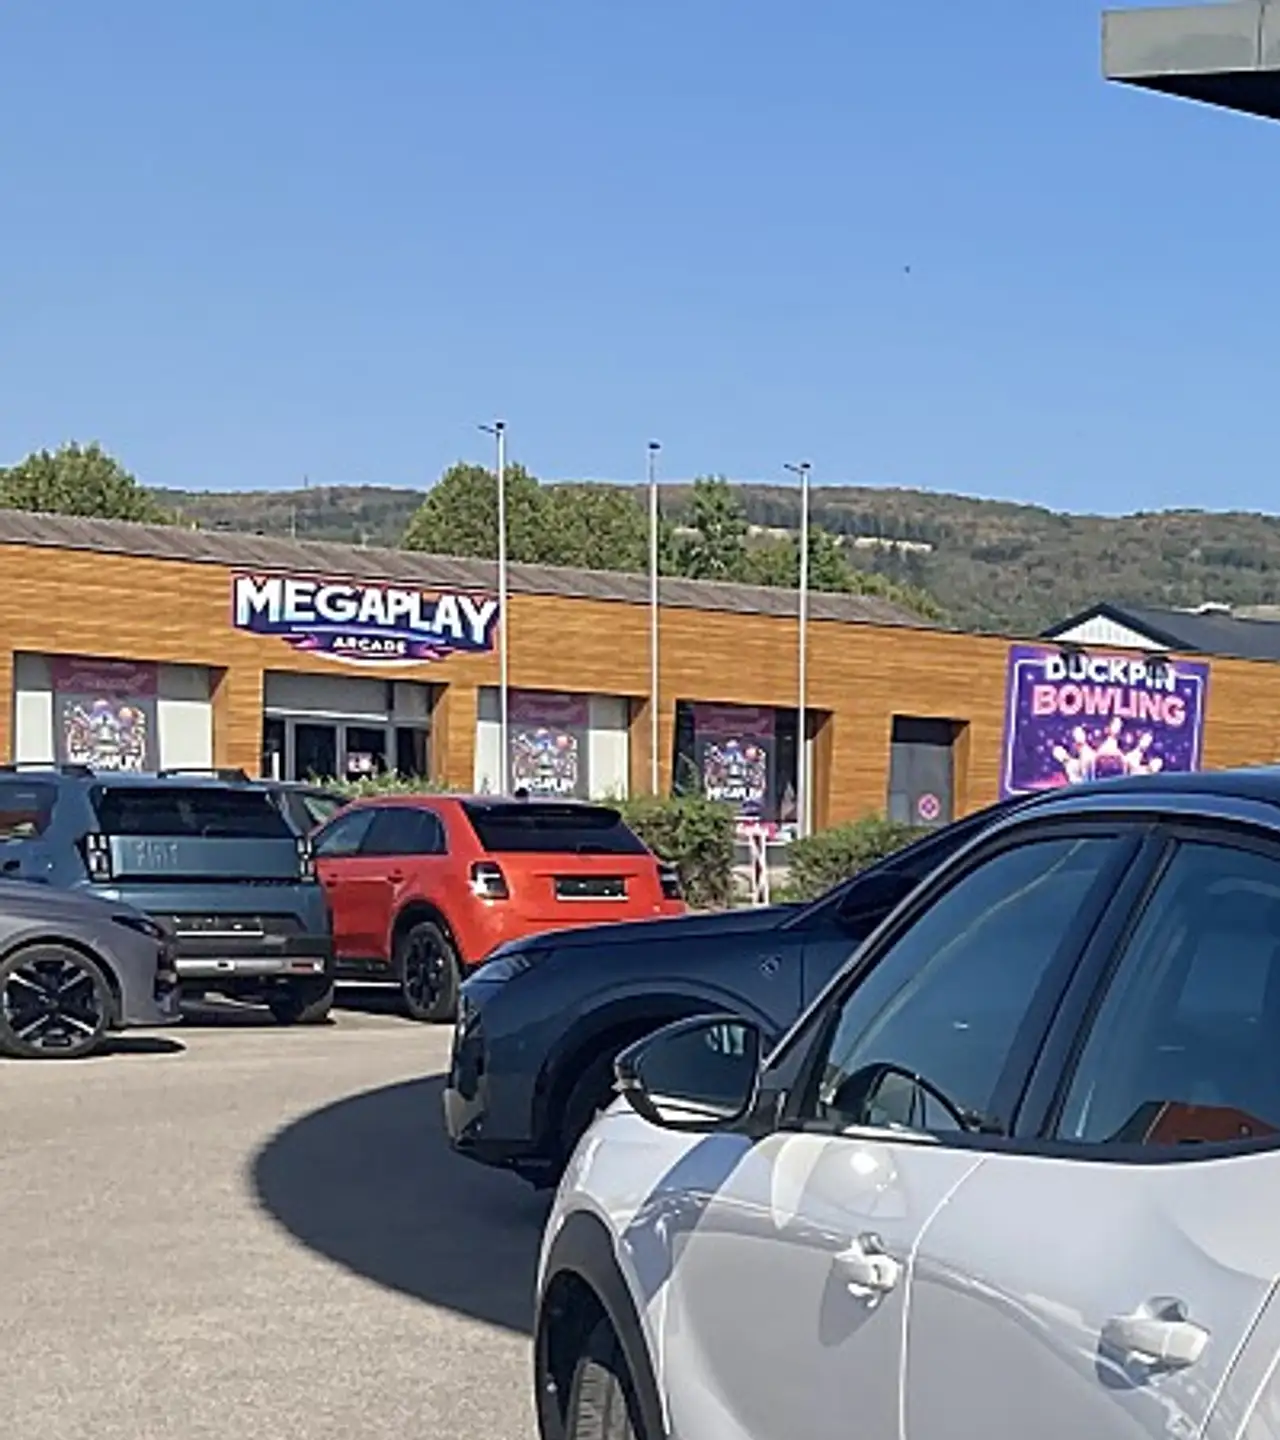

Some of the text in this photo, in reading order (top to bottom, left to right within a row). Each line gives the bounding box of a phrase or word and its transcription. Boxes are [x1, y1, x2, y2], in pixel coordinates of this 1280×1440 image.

[236, 576, 497, 644] MEGAPLAY
[332, 636, 407, 655] ARCADE
[1044, 653, 1177, 692] DUCKPIN
[1032, 683, 1187, 726] BOWLING
